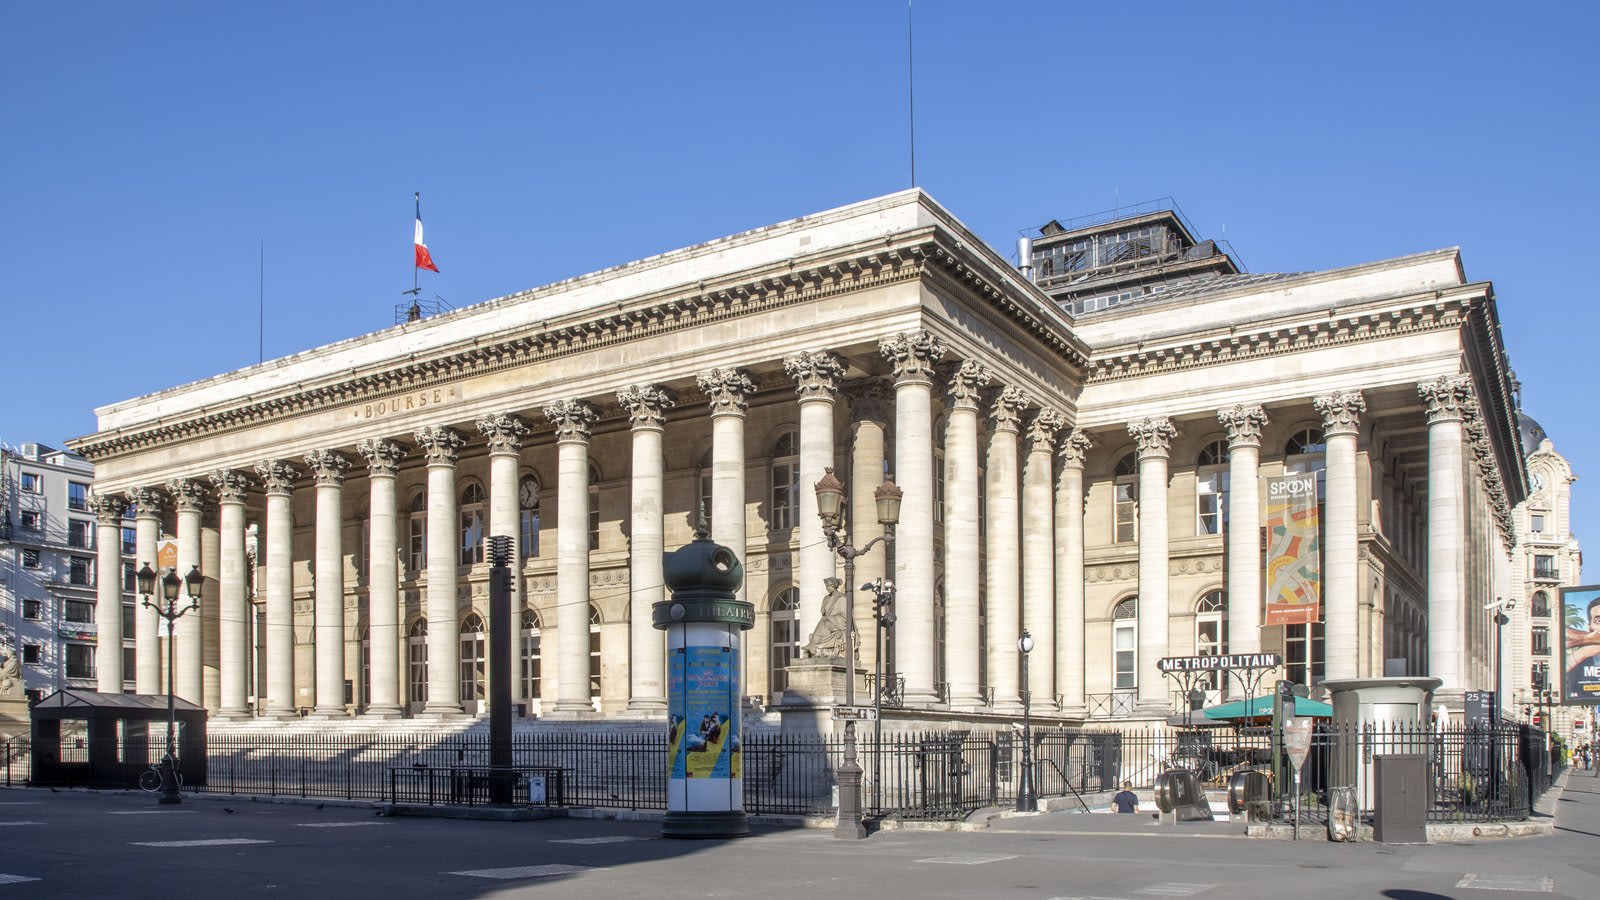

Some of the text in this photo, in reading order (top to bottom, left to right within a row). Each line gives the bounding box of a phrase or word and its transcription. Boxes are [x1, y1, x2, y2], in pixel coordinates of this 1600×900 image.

[365, 390, 442, 419] BOURSE
[1270, 478, 1313, 495] SPOON
[1162, 654, 1275, 671] METROPOLITAIN
[1466, 693, 1479, 701] 25
[1258, 707, 1275, 715] SPOO
